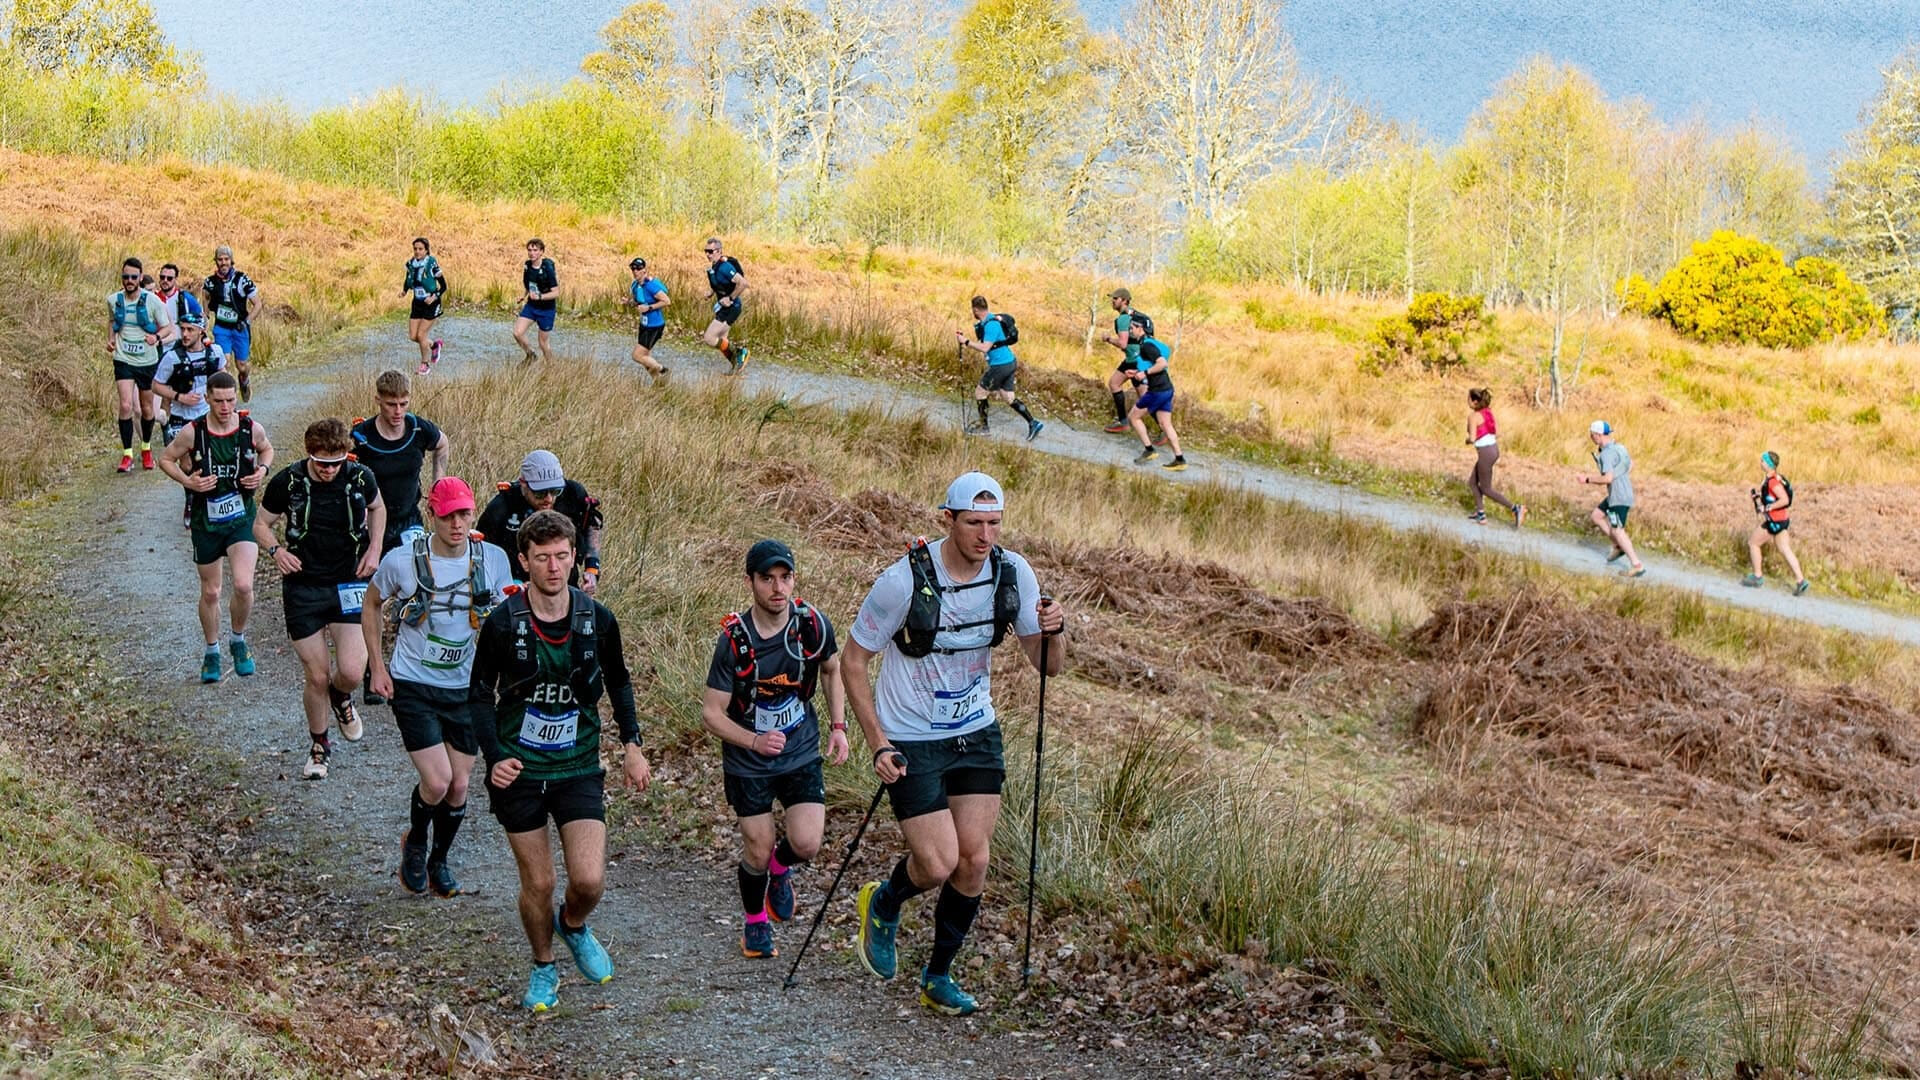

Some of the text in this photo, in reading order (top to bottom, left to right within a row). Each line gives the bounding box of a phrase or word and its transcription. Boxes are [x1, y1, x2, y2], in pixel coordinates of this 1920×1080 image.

[219, 500, 234, 516] 405
[439, 647, 462, 662] 290
[773, 709, 792, 728] 201
[538, 723, 565, 741] 407
